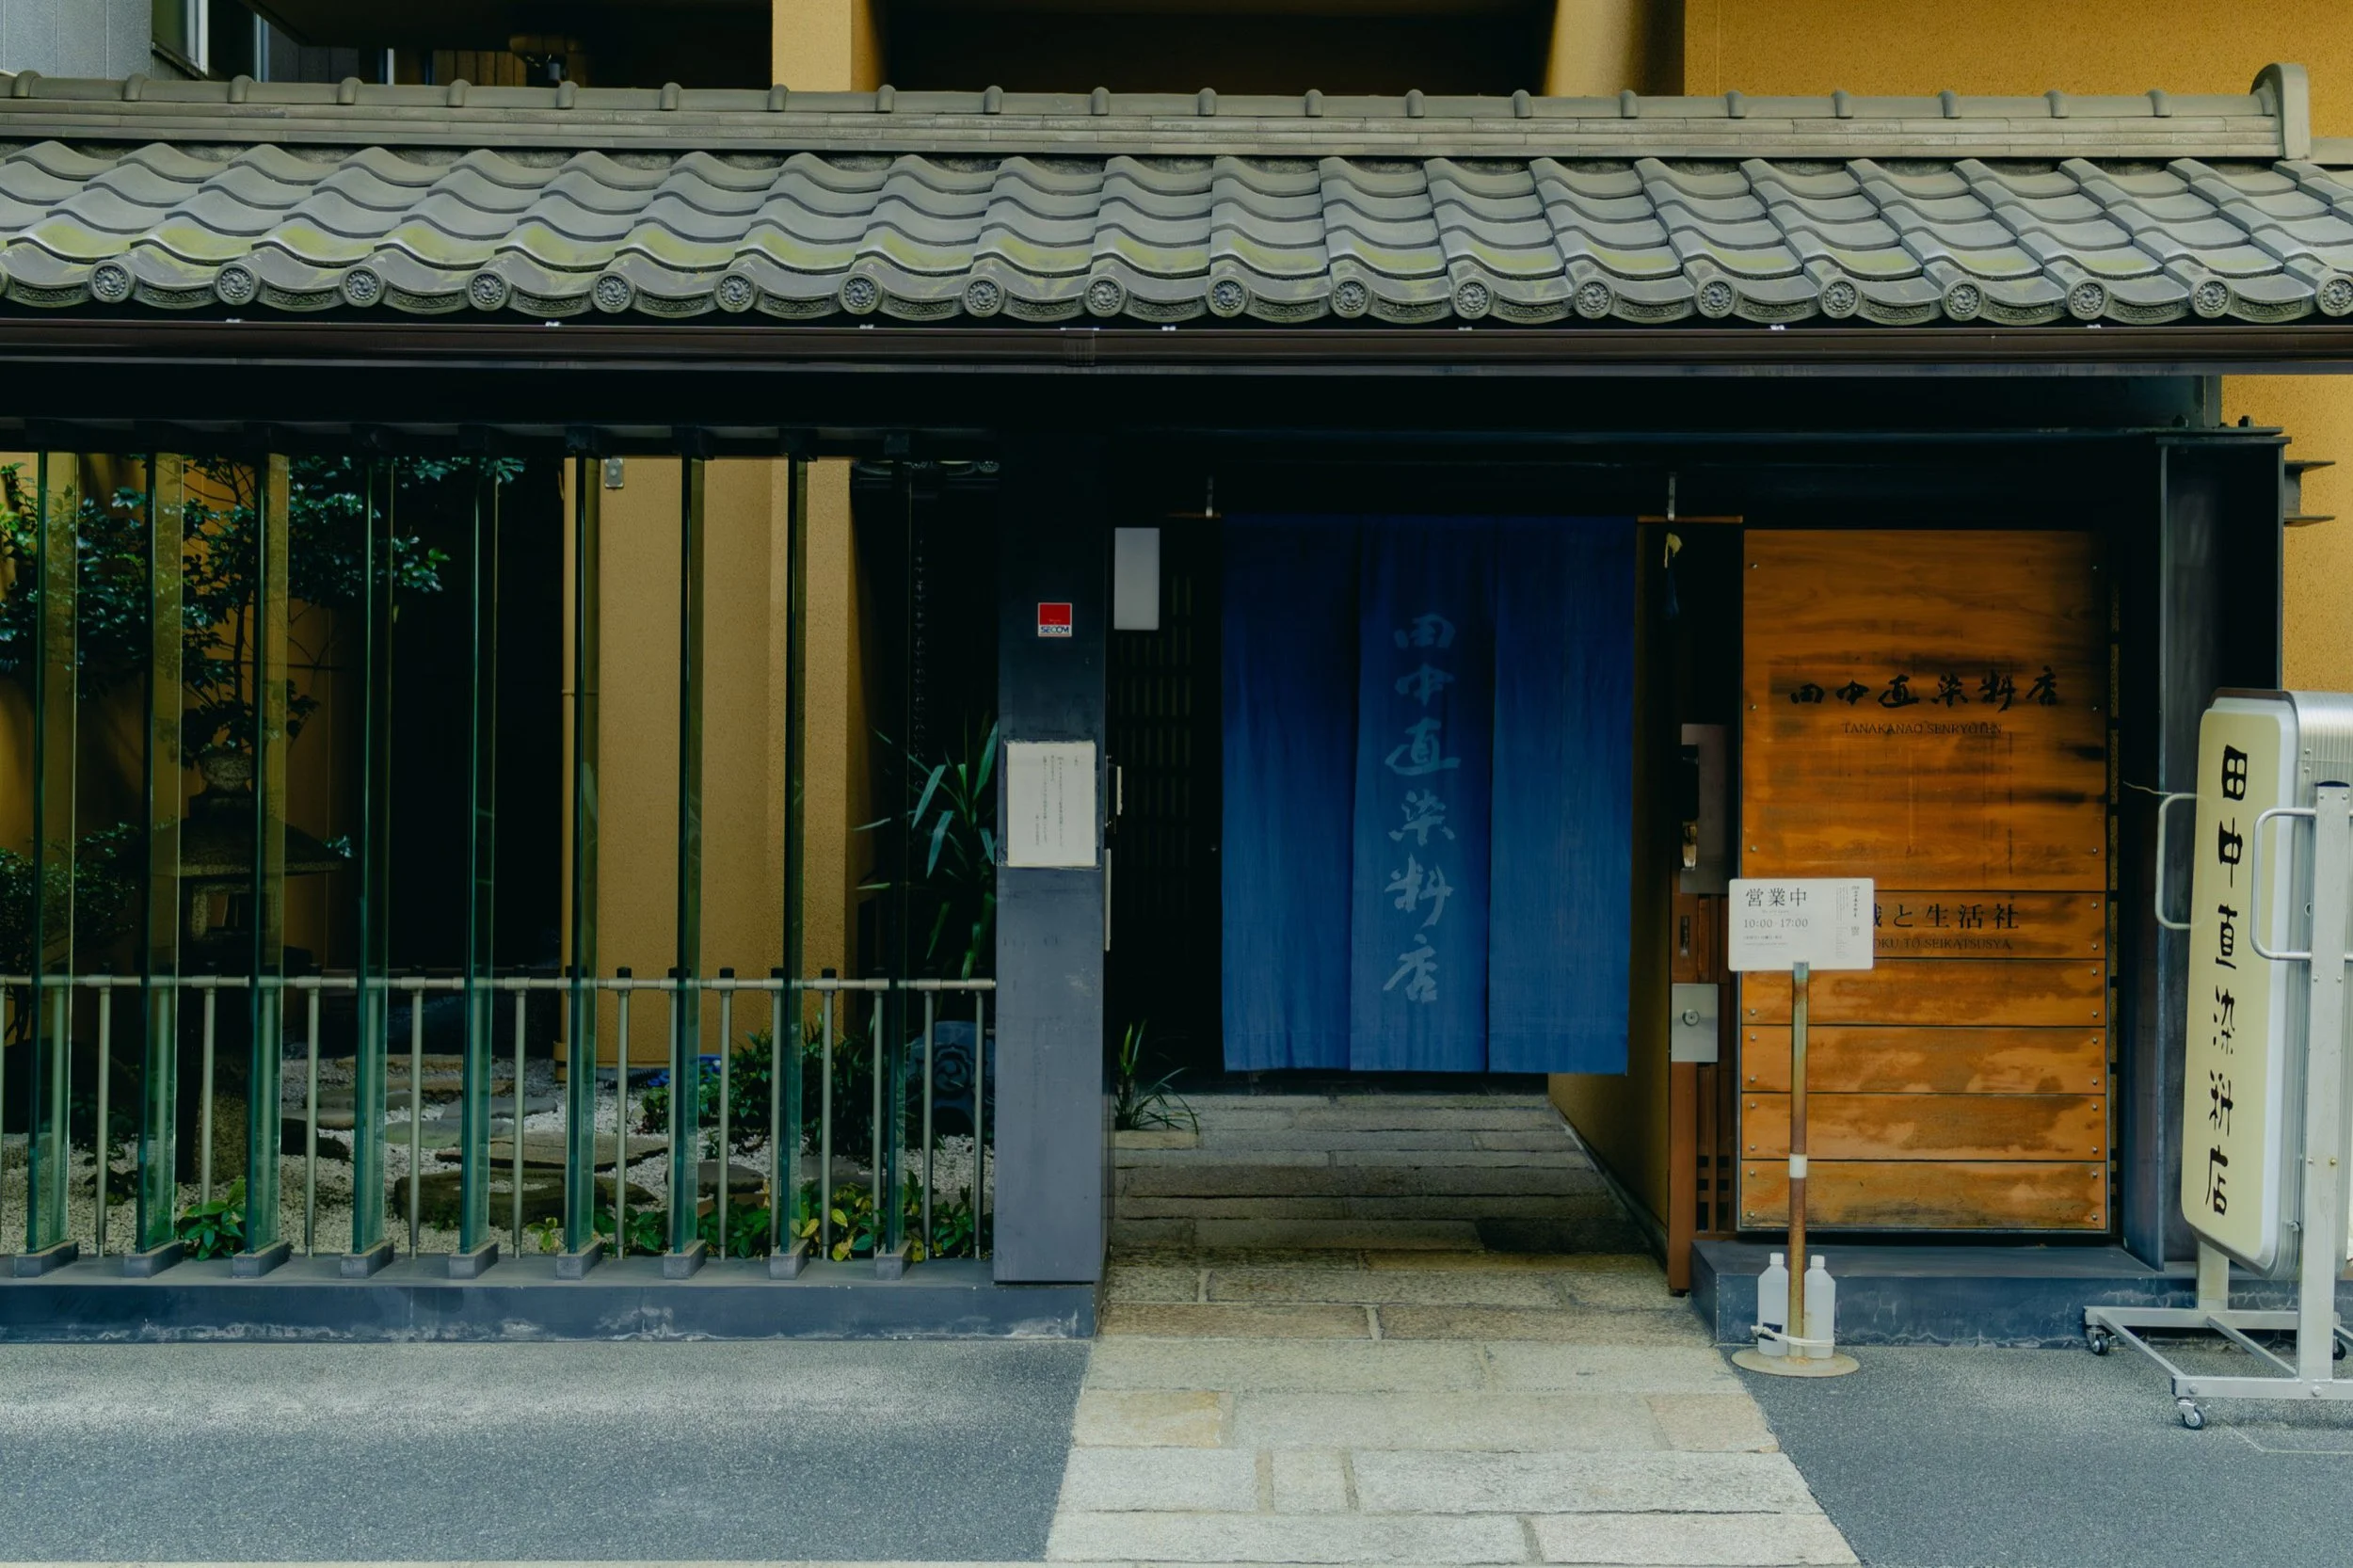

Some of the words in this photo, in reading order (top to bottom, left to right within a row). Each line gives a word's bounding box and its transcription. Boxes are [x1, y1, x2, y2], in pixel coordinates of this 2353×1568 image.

[1040, 625, 1069, 634] SECOM
[1842, 722, 1922, 734] TANAKANAO
[1746, 888, 1807, 907] 営業中
[1903, 938, 1921, 950] TO
